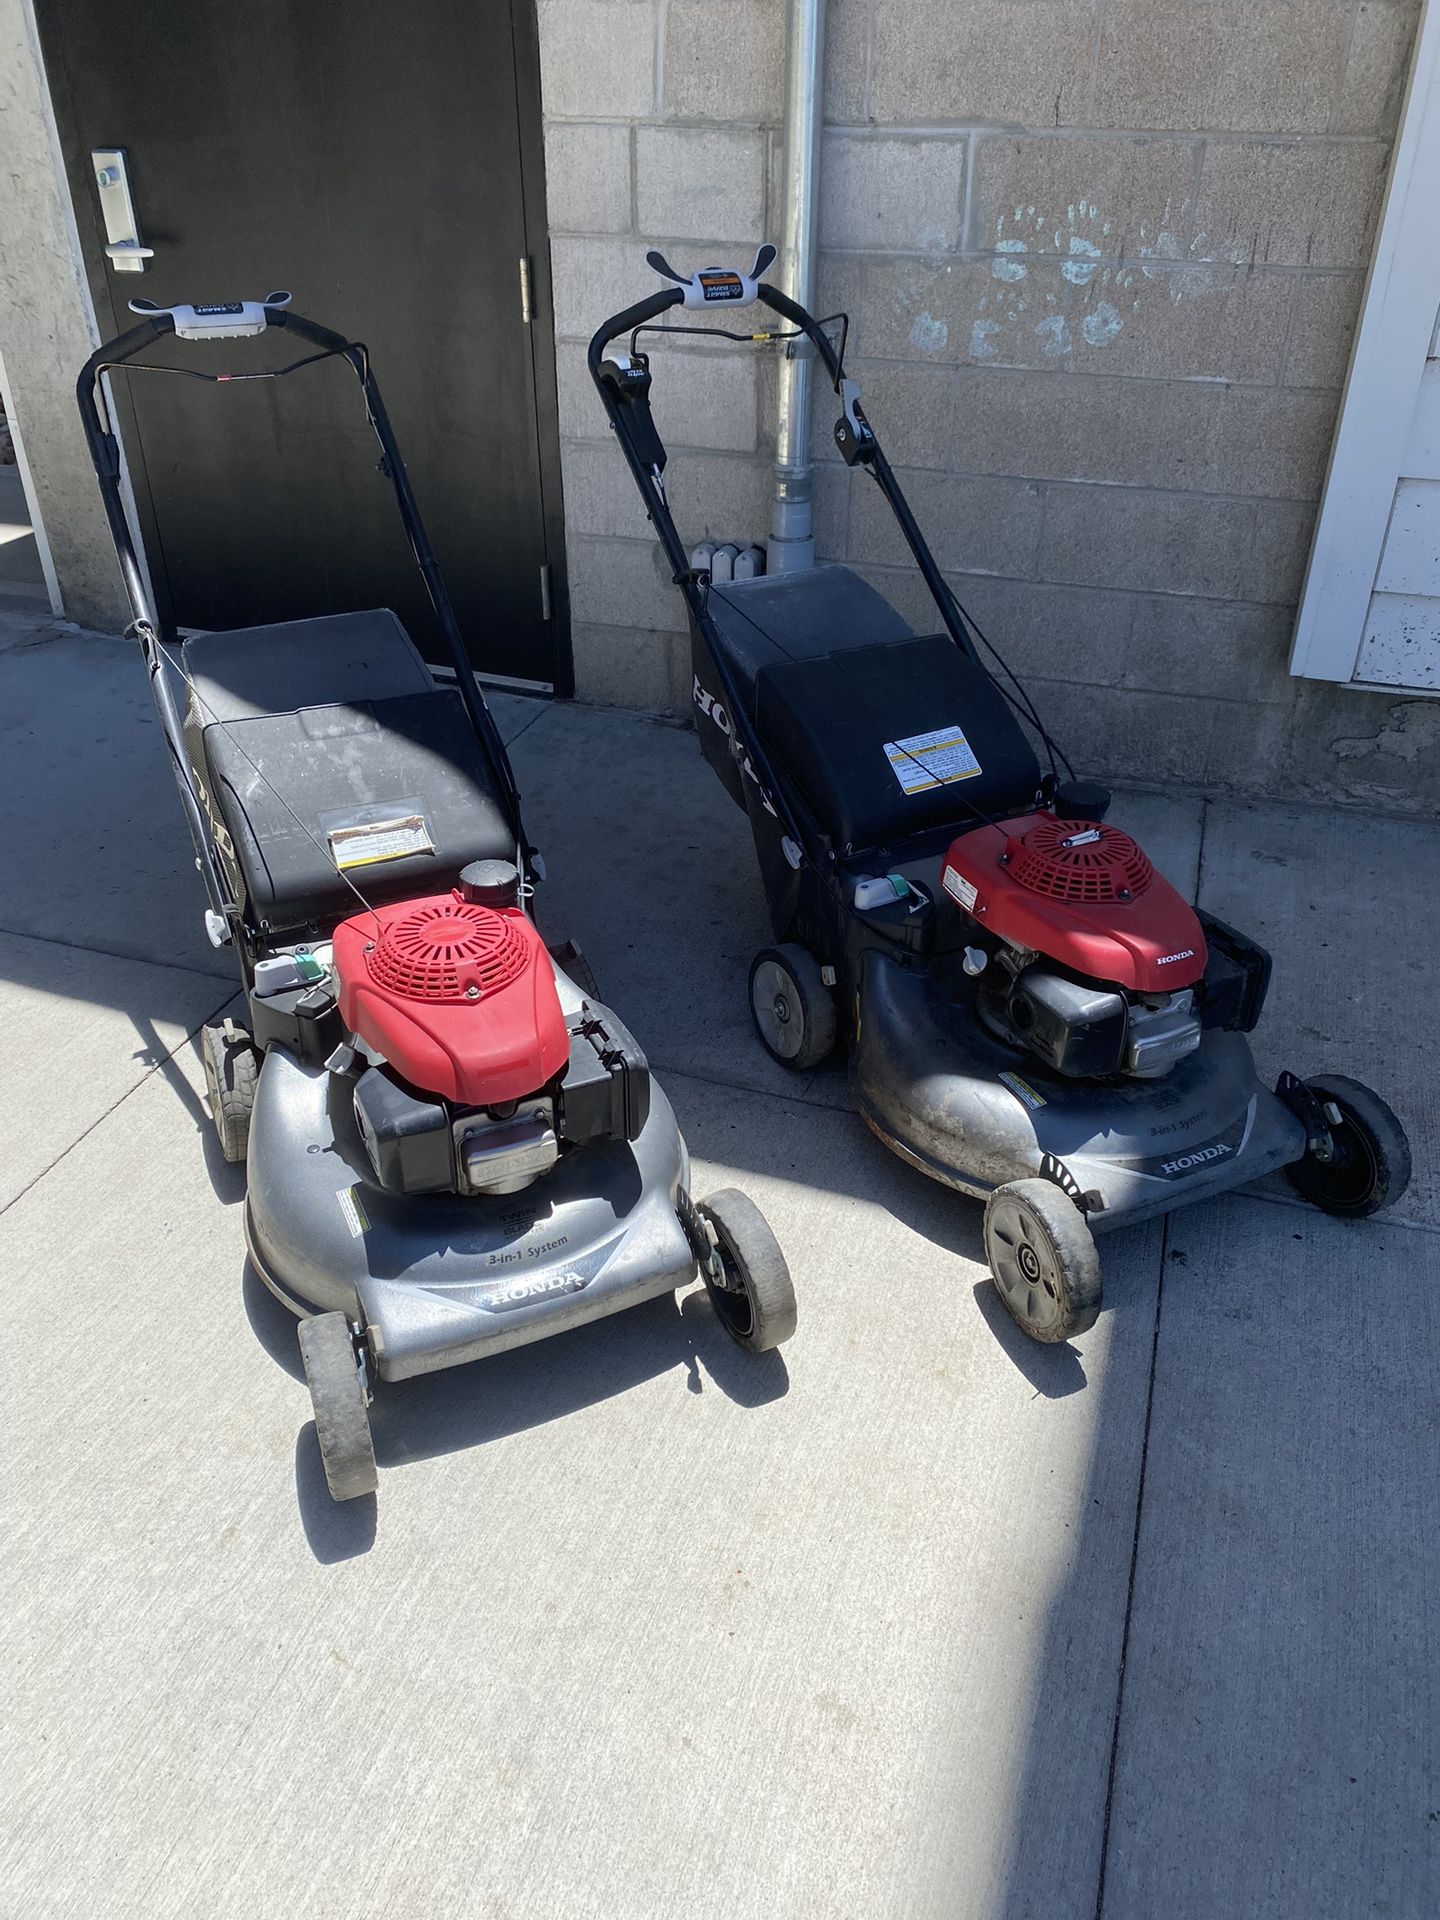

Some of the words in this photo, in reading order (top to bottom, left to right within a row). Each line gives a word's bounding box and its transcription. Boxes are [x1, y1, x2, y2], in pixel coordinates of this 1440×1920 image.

[1156, 949, 1194, 965] HONDA
[1161, 1143, 1233, 1175] HONDA
[499, 1207, 537, 1222] TWIN
[489, 1250, 523, 1265] 3-in-1
[527, 1235, 569, 1257] System
[488, 1271, 585, 1305] HONDA
